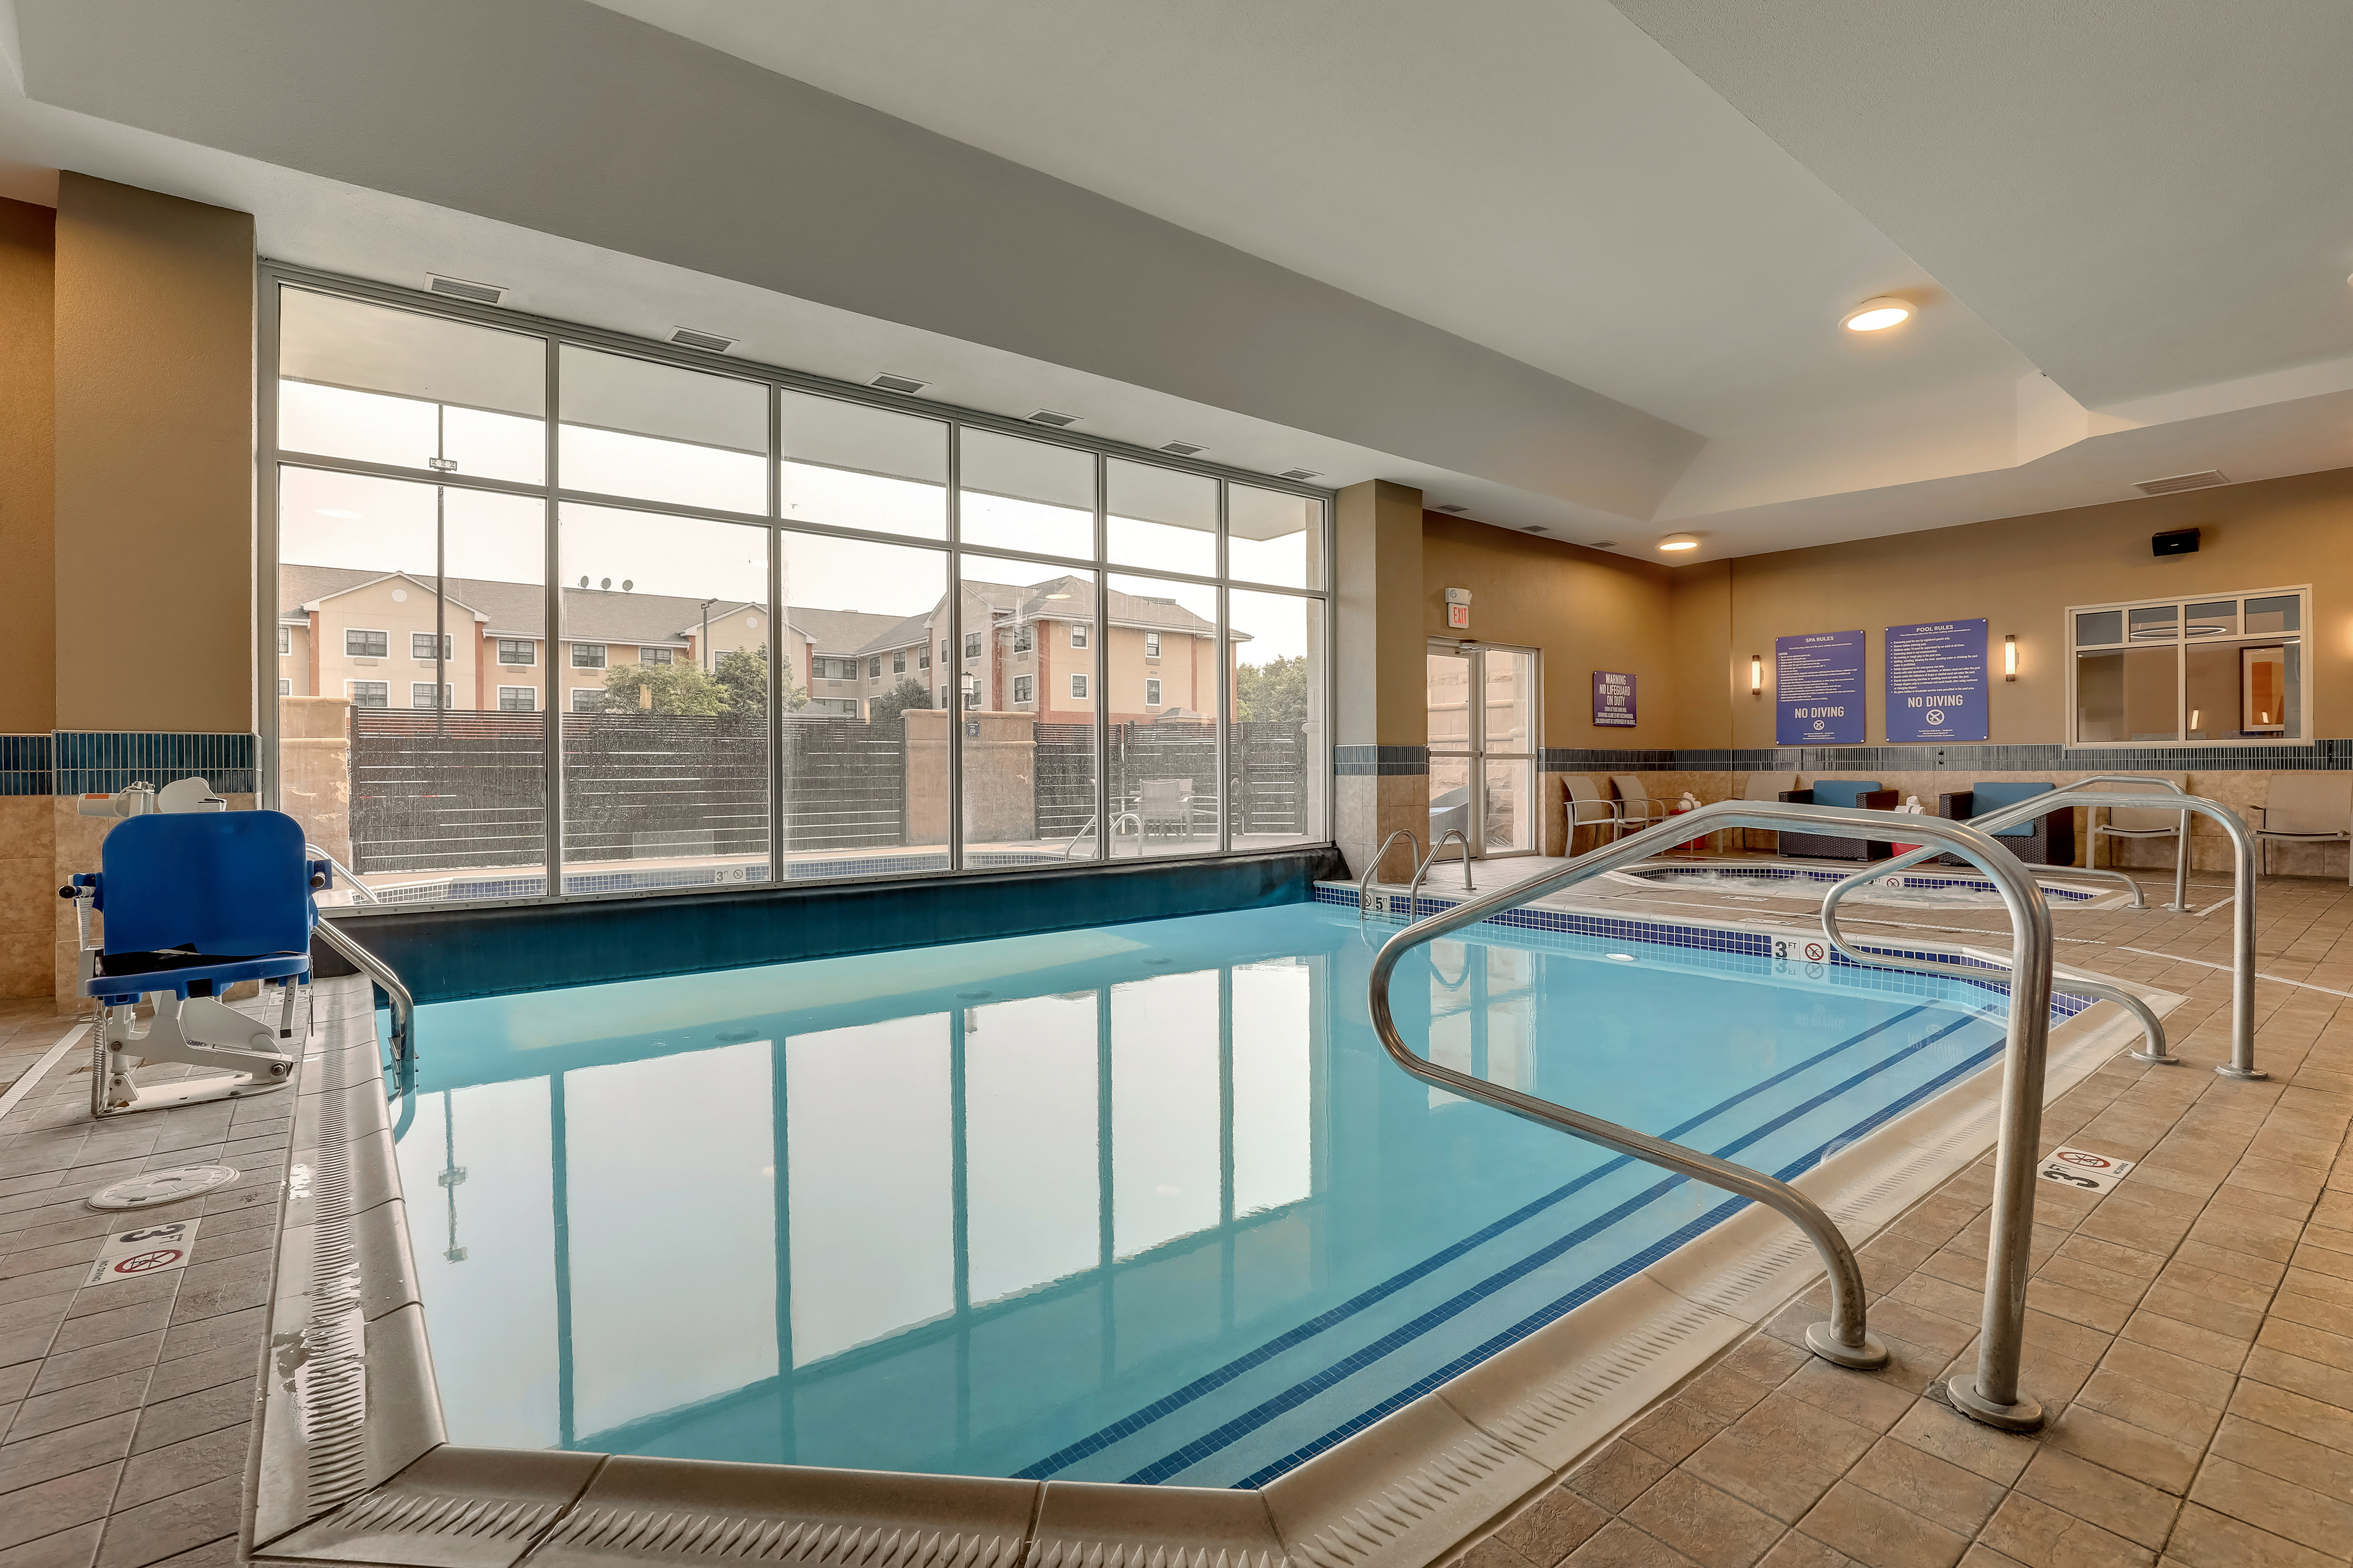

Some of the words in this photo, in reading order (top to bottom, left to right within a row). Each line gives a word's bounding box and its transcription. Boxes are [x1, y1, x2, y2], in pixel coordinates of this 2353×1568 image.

[1454, 607, 1467, 624] EXIT
[1606, 674, 1626, 685] WARNING
[1599, 684, 1606, 694] NO
[1607, 685, 1630, 696] LIFEGUARD
[1607, 695, 1613, 705] ON
[1614, 697, 1625, 706] DUTY
[1908, 697, 1923, 707] NO
[1926, 695, 1963, 707] DIVING
[1795, 708, 1808, 718] NO
[1811, 706, 1845, 718] DIVING
[717, 871, 723, 881] 3
[1376, 897, 1383, 909] 5
[1775, 941, 1787, 958] 3
[2048, 1164, 2070, 1173] FT
[2043, 1171, 2099, 1188] 3
[119, 1224, 186, 1243] 3
[159, 1234, 183, 1244] FT
[92, 1267, 106, 1282] DIVING
